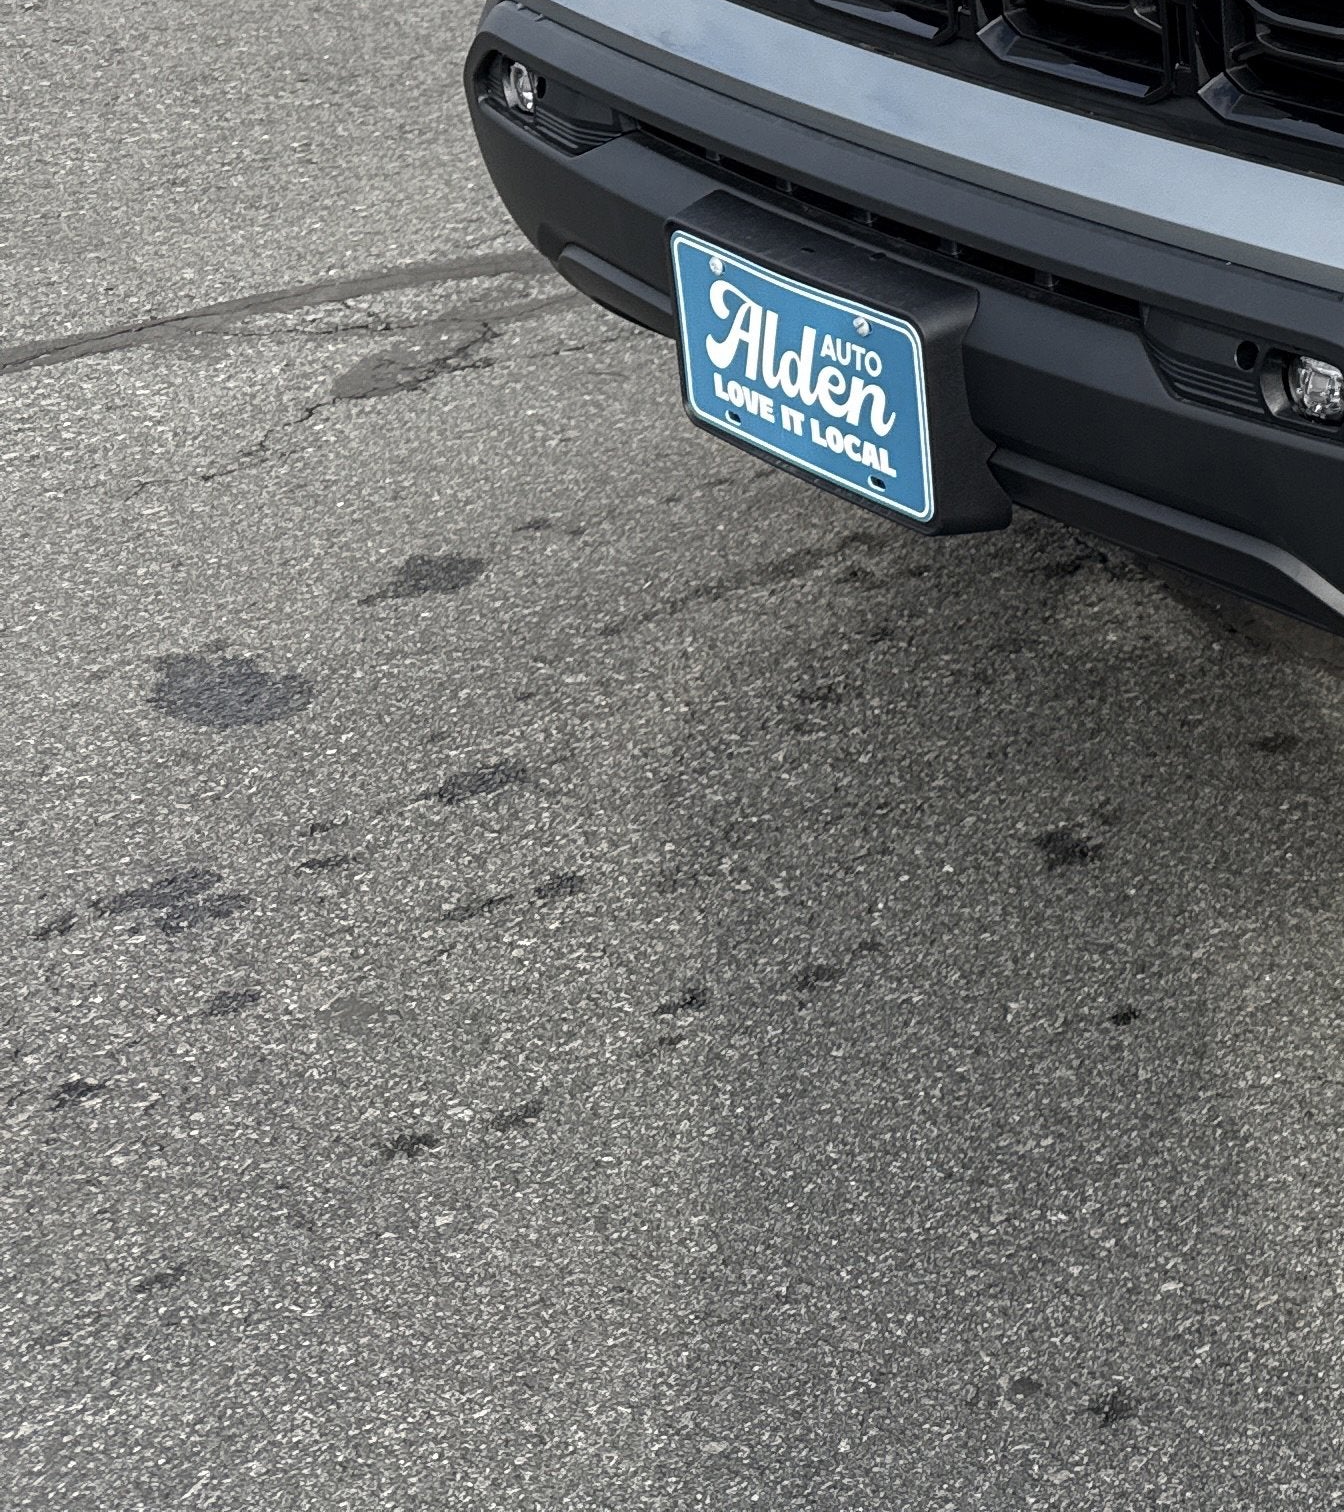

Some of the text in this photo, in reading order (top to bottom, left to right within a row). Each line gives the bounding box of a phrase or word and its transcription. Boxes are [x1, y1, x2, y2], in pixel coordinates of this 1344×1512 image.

[706, 279, 896, 437] Alden
[820, 334, 882, 377] AUTO
[713, 372, 897, 477] LOVE IT LOCAL
